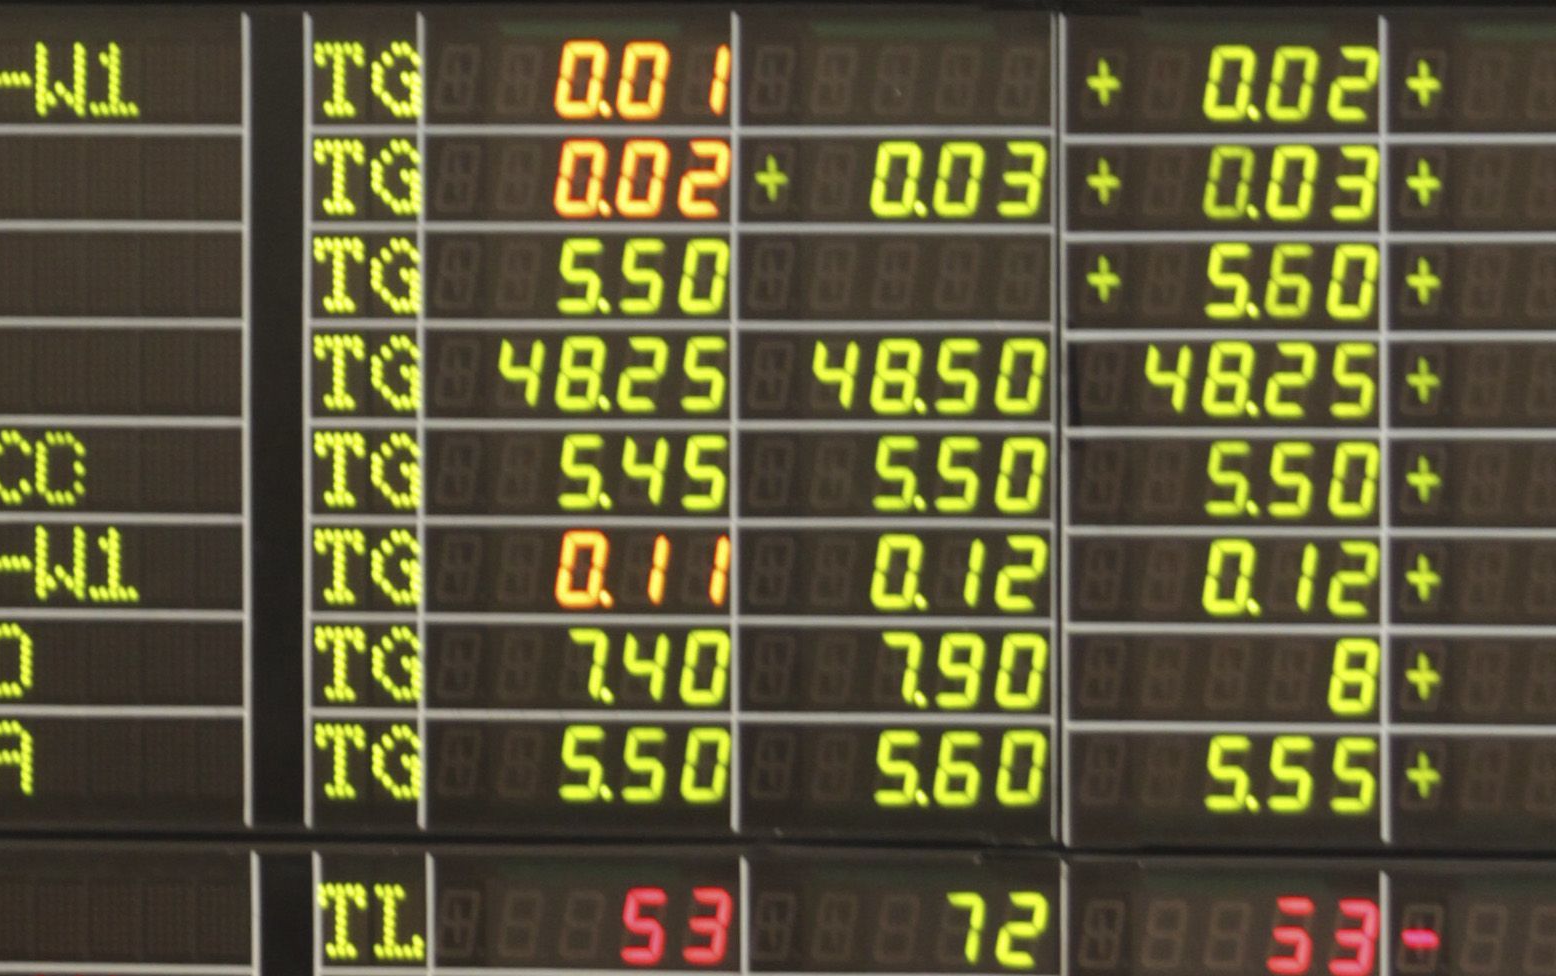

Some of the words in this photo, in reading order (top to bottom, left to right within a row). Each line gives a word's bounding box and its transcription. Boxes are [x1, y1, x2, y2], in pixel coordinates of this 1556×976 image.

[313, 41, 421, 118] TG
[553, 39, 732, 121] 0.01
[1203, 45, 1380, 122] 0.02
[313, 139, 420, 215] TG
[553, 136, 732, 219] 0.02
[870, 141, 1047, 218] 0.03
[1203, 144, 1380, 221] 0.03
[313, 237, 420, 314] TG
[557, 238, 730, 315] 5.50
[1205, 241, 1380, 320] 5.60
[313, 334, 419, 410] TG
[498, 336, 726, 412] 48.25
[812, 338, 1047, 414] 48.50
[1145, 340, 1376, 418] 48.25
[314, 431, 419, 508] TG
[558, 434, 727, 511] 5.45
[873, 436, 1047, 513] 5.50
[1205, 441, 1380, 518] 5.50
[313, 528, 420, 606] TG
[554, 529, 731, 609] 0.11
[870, 534, 1048, 611] 0.12
[1202, 539, 1380, 617] 0.12
[314, 626, 421, 701] TG
[569, 628, 731, 705] 7.40
[883, 632, 1048, 709] 7.90
[1328, 638, 1380, 715] 8
[315, 723, 420, 800] TG
[559, 725, 732, 803] 5.50
[875, 730, 1047, 806] 5.60
[1205, 735, 1376, 813] 5.55
[319, 883, 425, 960] TL
[620, 887, 733, 965] 53
[948, 892, 1048, 968] 72
